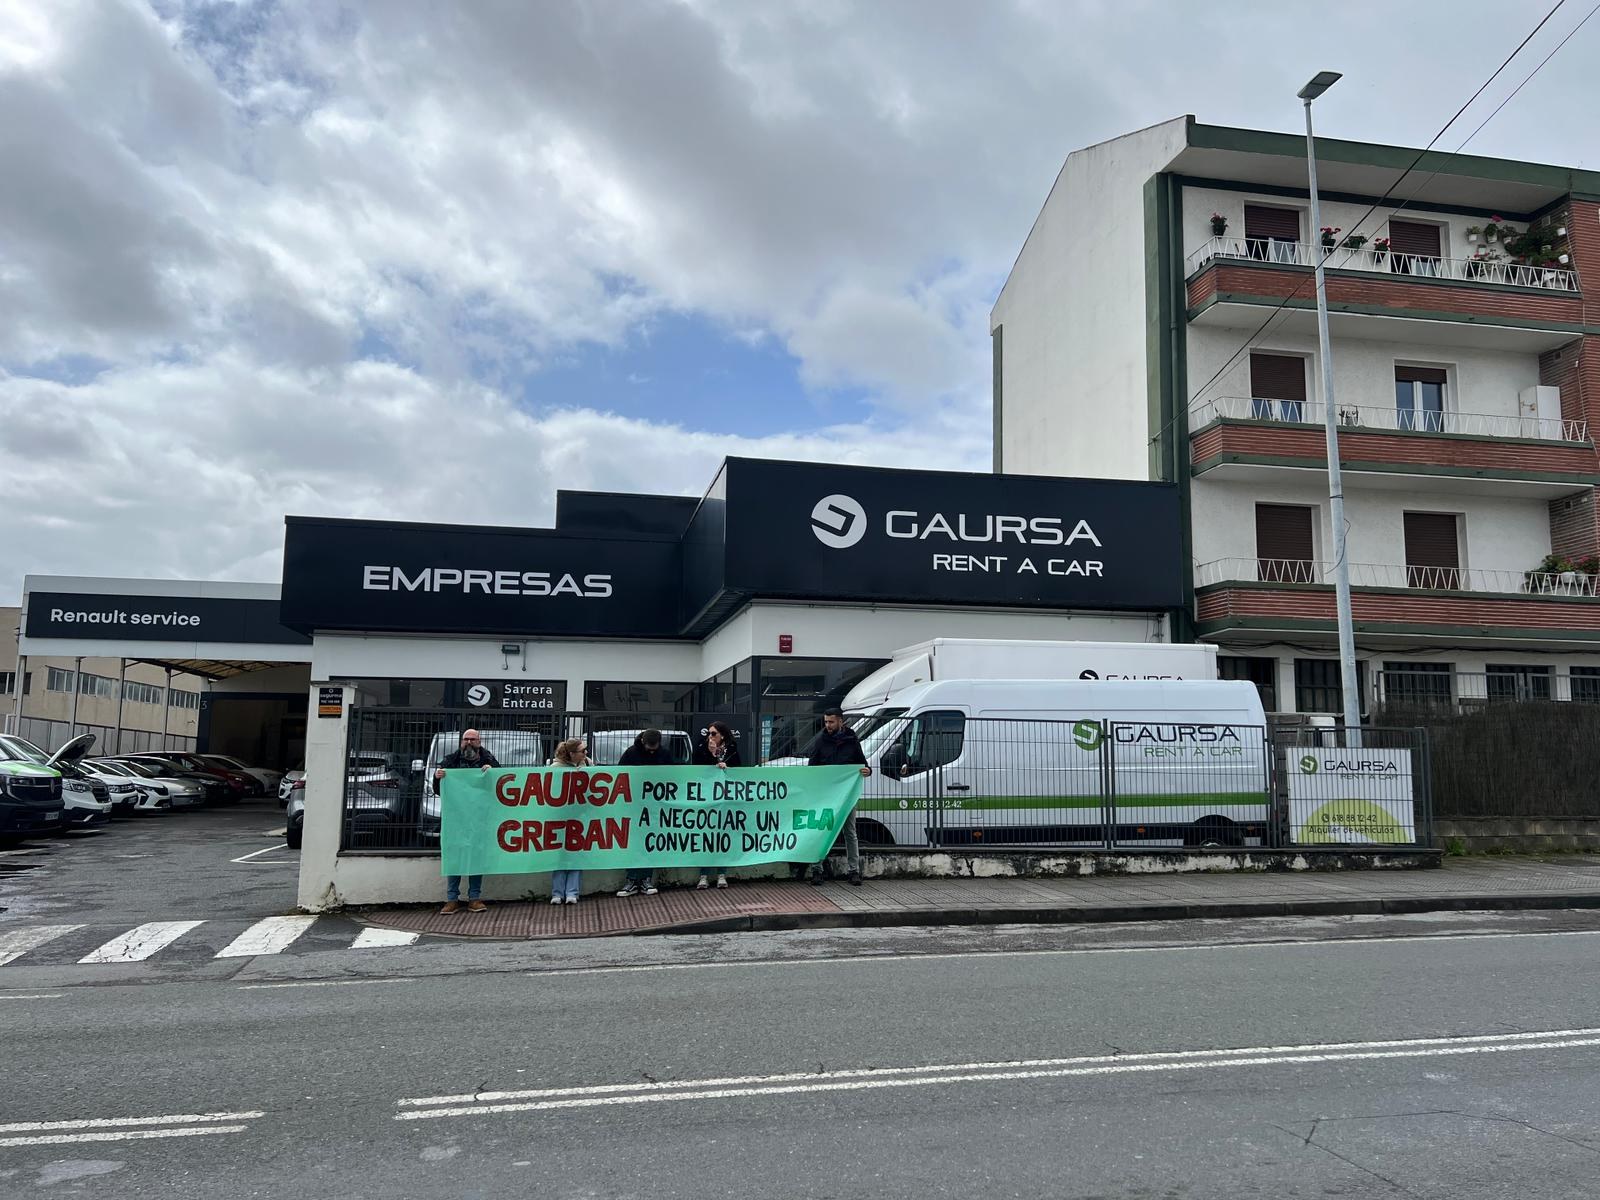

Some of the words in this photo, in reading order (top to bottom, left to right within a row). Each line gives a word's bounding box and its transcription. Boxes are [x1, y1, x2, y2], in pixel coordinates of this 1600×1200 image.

[886, 510, 1102, 547] GAURSA
[933, 553, 1008, 573] RENT
[1017, 557, 1039, 574] A
[1047, 559, 1104, 577] CAR
[362, 565, 613, 598] EMPRESAS
[50, 608, 127, 624] Renault
[130, 611, 201, 626] service
[504, 683, 553, 695] Sarrera
[502, 697, 553, 709] Entrada
[1115, 725, 1240, 743] GAURSA
[1143, 747, 1184, 757] RENT
[1193, 747, 1205, 757] A
[1210, 747, 1242, 757] CAR
[1324, 760, 1397, 771] GAURSA
[495, 771, 633, 807] GAURSA
[642, 781, 678, 801] POR
[687, 782, 706, 801] EL
[713, 780, 788, 801] DERECHO
[912, 800, 928, 808] 618
[638, 807, 650, 827] A
[659, 808, 747, 831] NEGOCIAR
[756, 811, 780, 831] UN
[792, 808, 835, 831] ELA
[497, 817, 632, 853] GREBAN
[644, 832, 731, 853] CONVENIO
[742, 832, 798, 853] DIGNO
